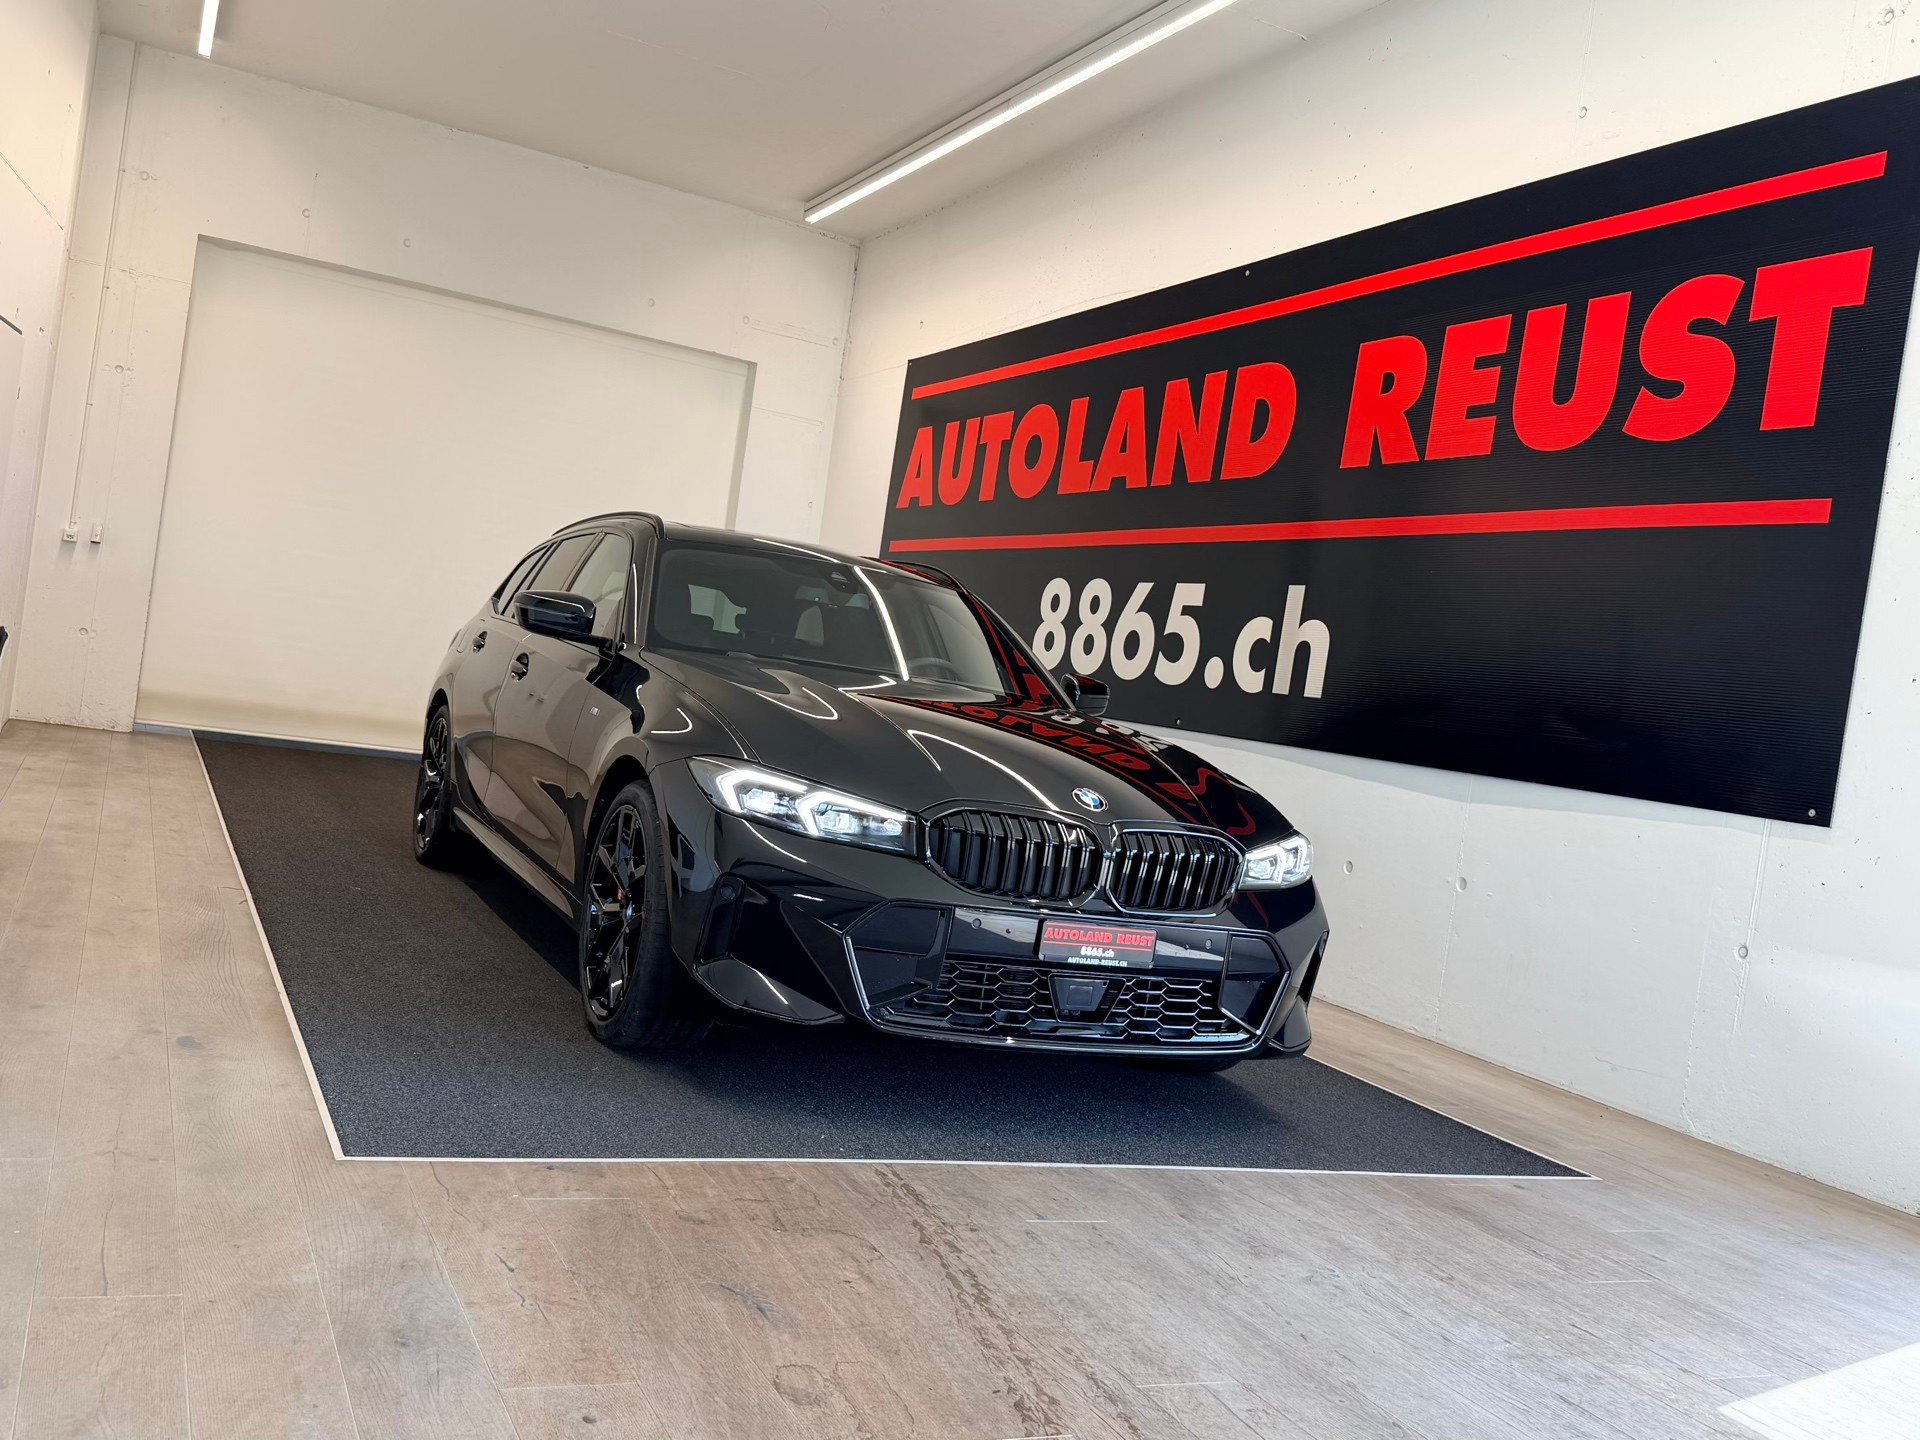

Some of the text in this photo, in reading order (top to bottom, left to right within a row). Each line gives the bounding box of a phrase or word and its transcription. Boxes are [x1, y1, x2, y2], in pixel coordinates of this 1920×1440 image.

[897, 247, 1873, 509] AUTOLAND REUST
[1032, 577, 1331, 699] 8865.ch
[1044, 928, 1155, 947] AUTOLAND REUST
[1067, 956, 1128, 967] AUTOLAND-REUST.CH
[1080, 946, 1115, 958] 8865.ch
